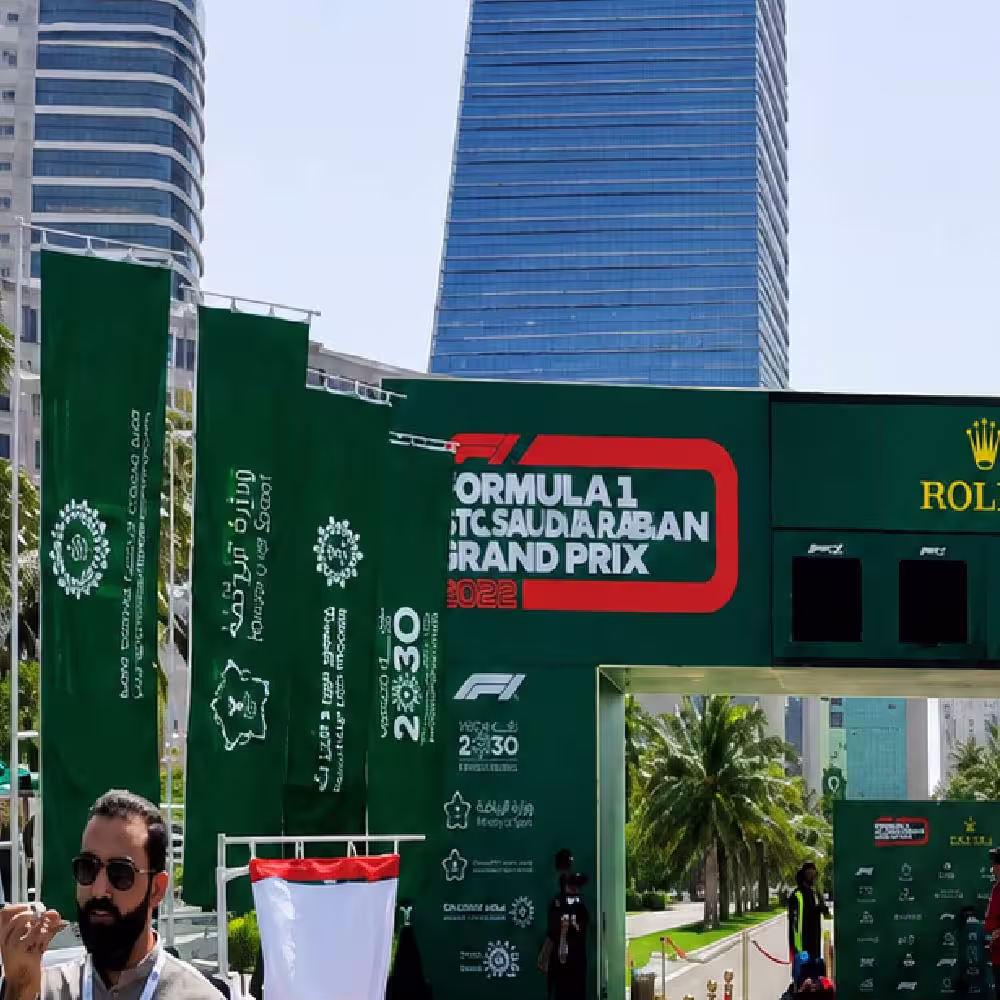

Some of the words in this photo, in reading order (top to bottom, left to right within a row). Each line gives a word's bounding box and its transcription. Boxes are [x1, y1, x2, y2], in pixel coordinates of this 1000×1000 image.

[453, 472, 610, 507] ORMULA
[617, 476, 638, 508] 1
[565, 542, 650, 574] PRIX
